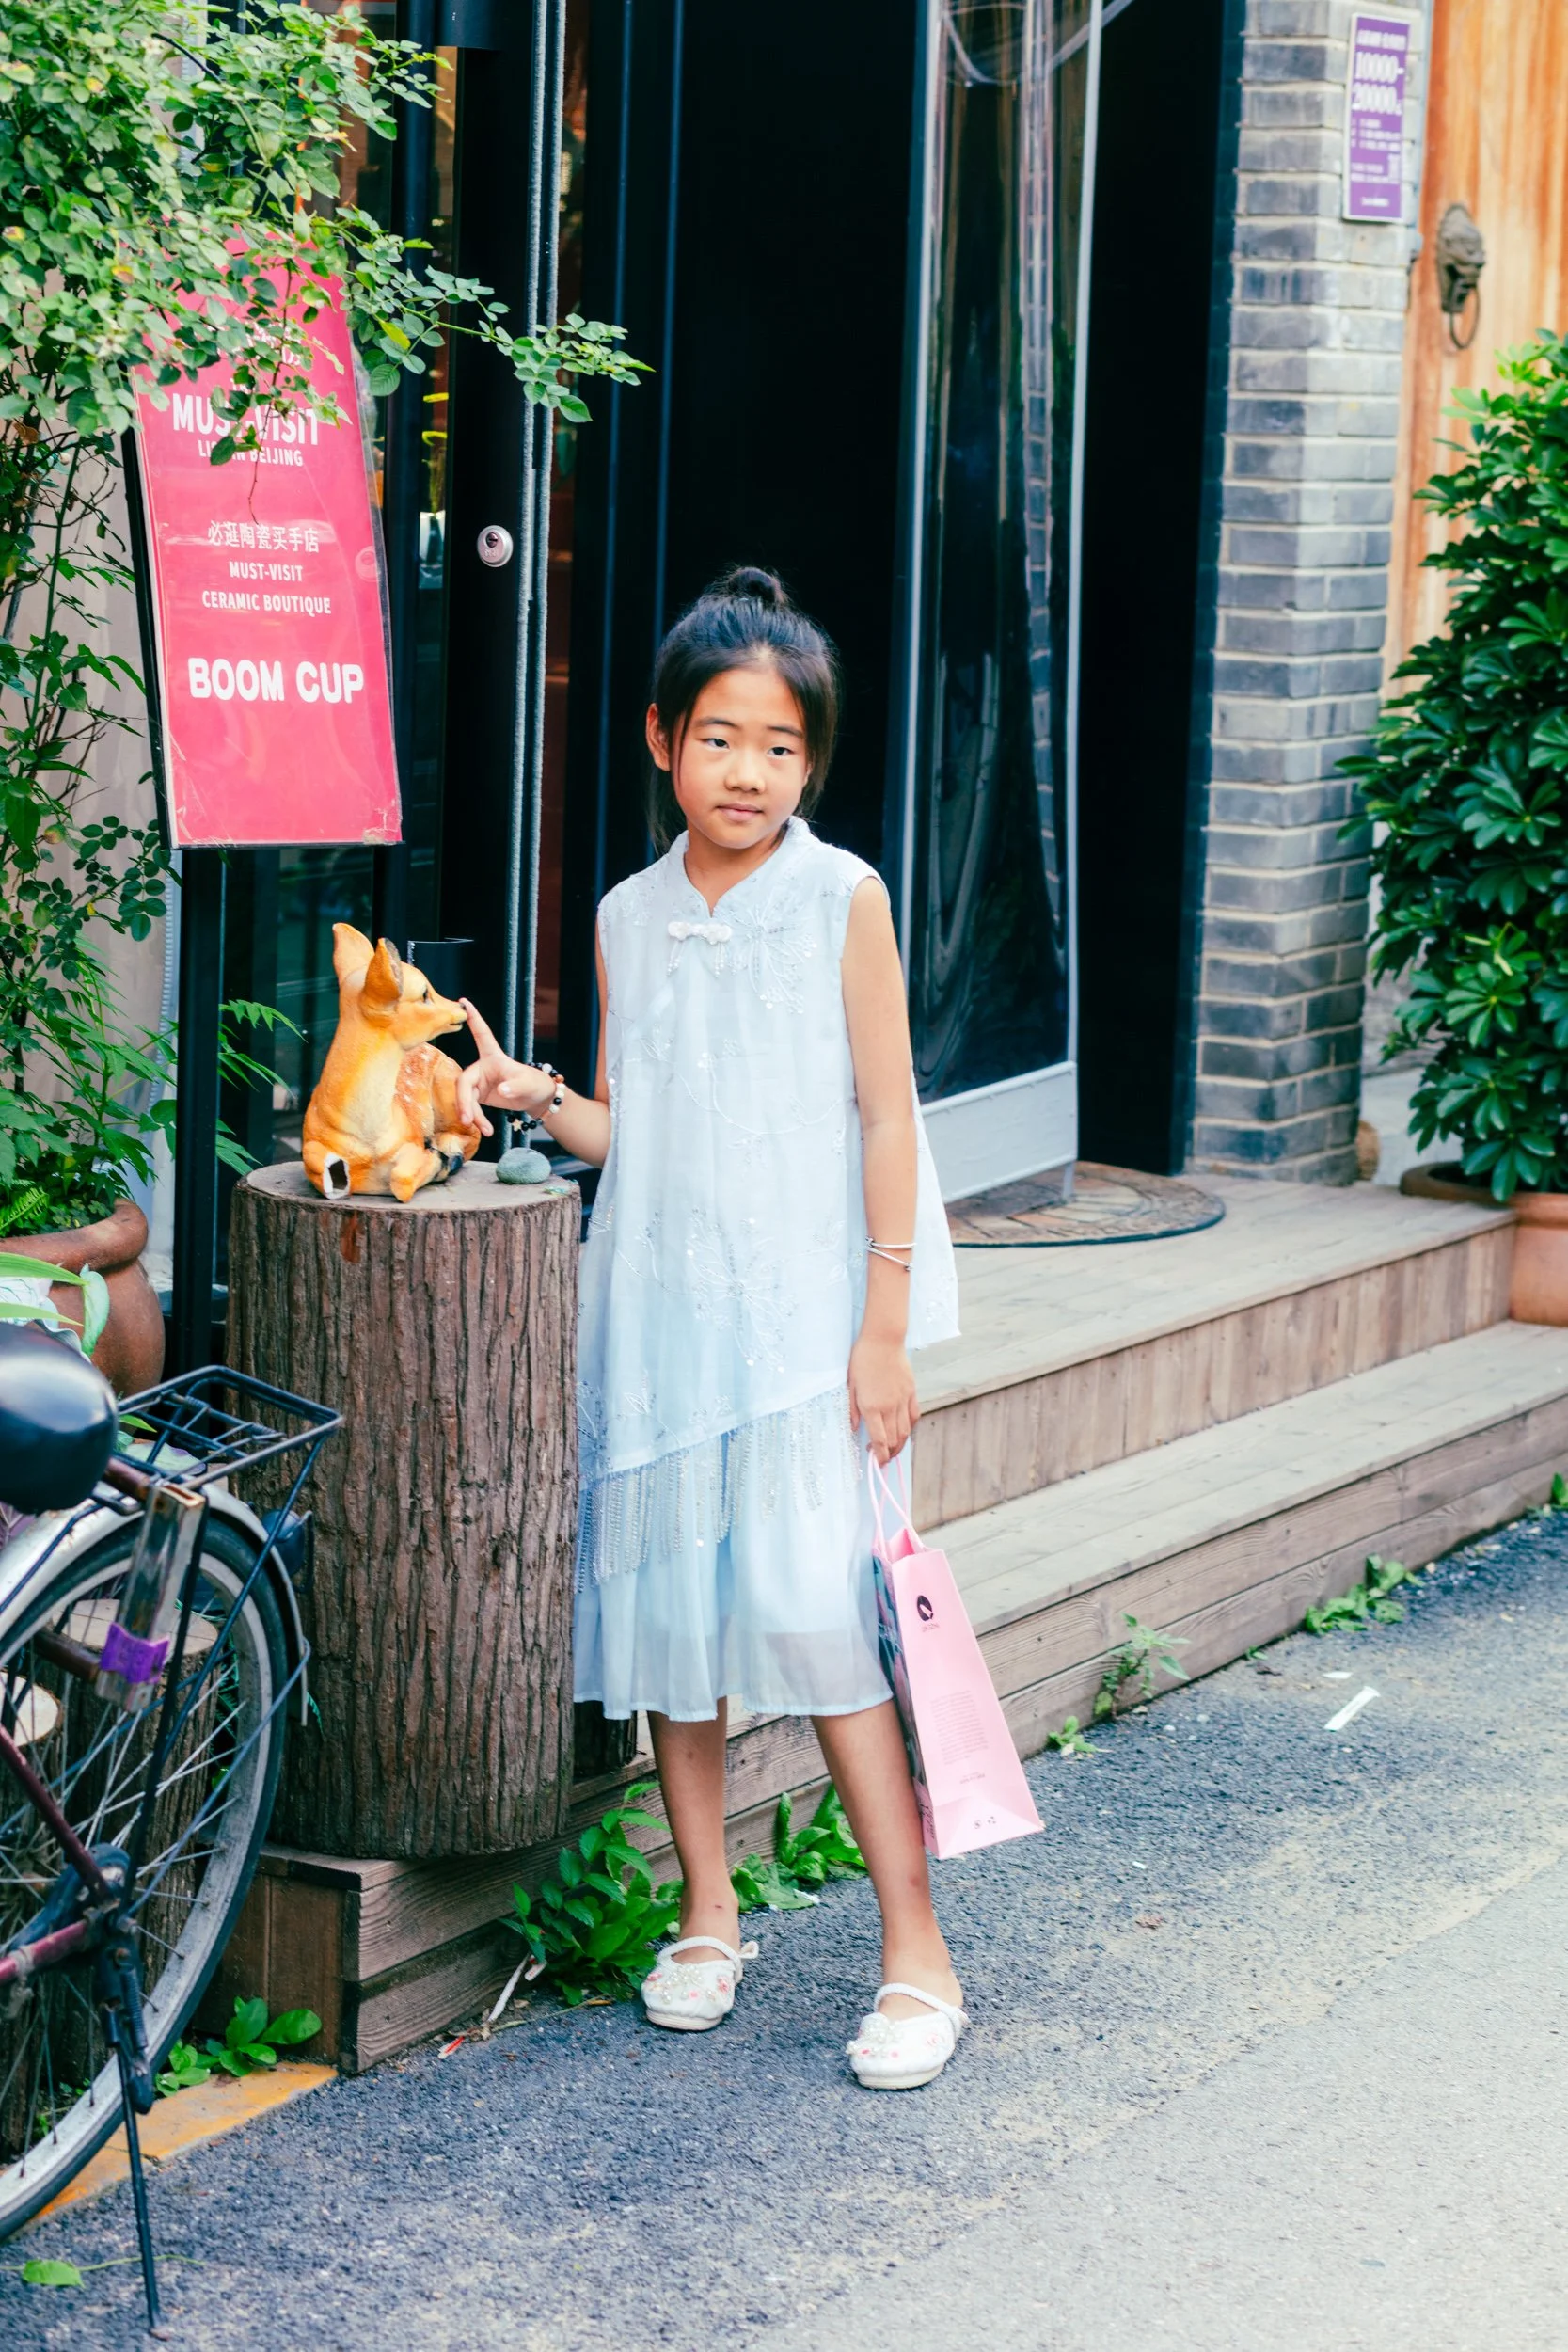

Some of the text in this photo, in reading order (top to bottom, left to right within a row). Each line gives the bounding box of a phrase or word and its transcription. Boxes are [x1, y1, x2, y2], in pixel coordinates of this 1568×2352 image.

[249, 447, 304, 467] BEIJING
[208, 520, 319, 553] 必逛陶瓷买手店
[229, 561, 303, 581] MUST-VISIT
[202, 590, 331, 617] CERAMIC BOUTIQUE
[187, 658, 364, 704] BOOM CUP
